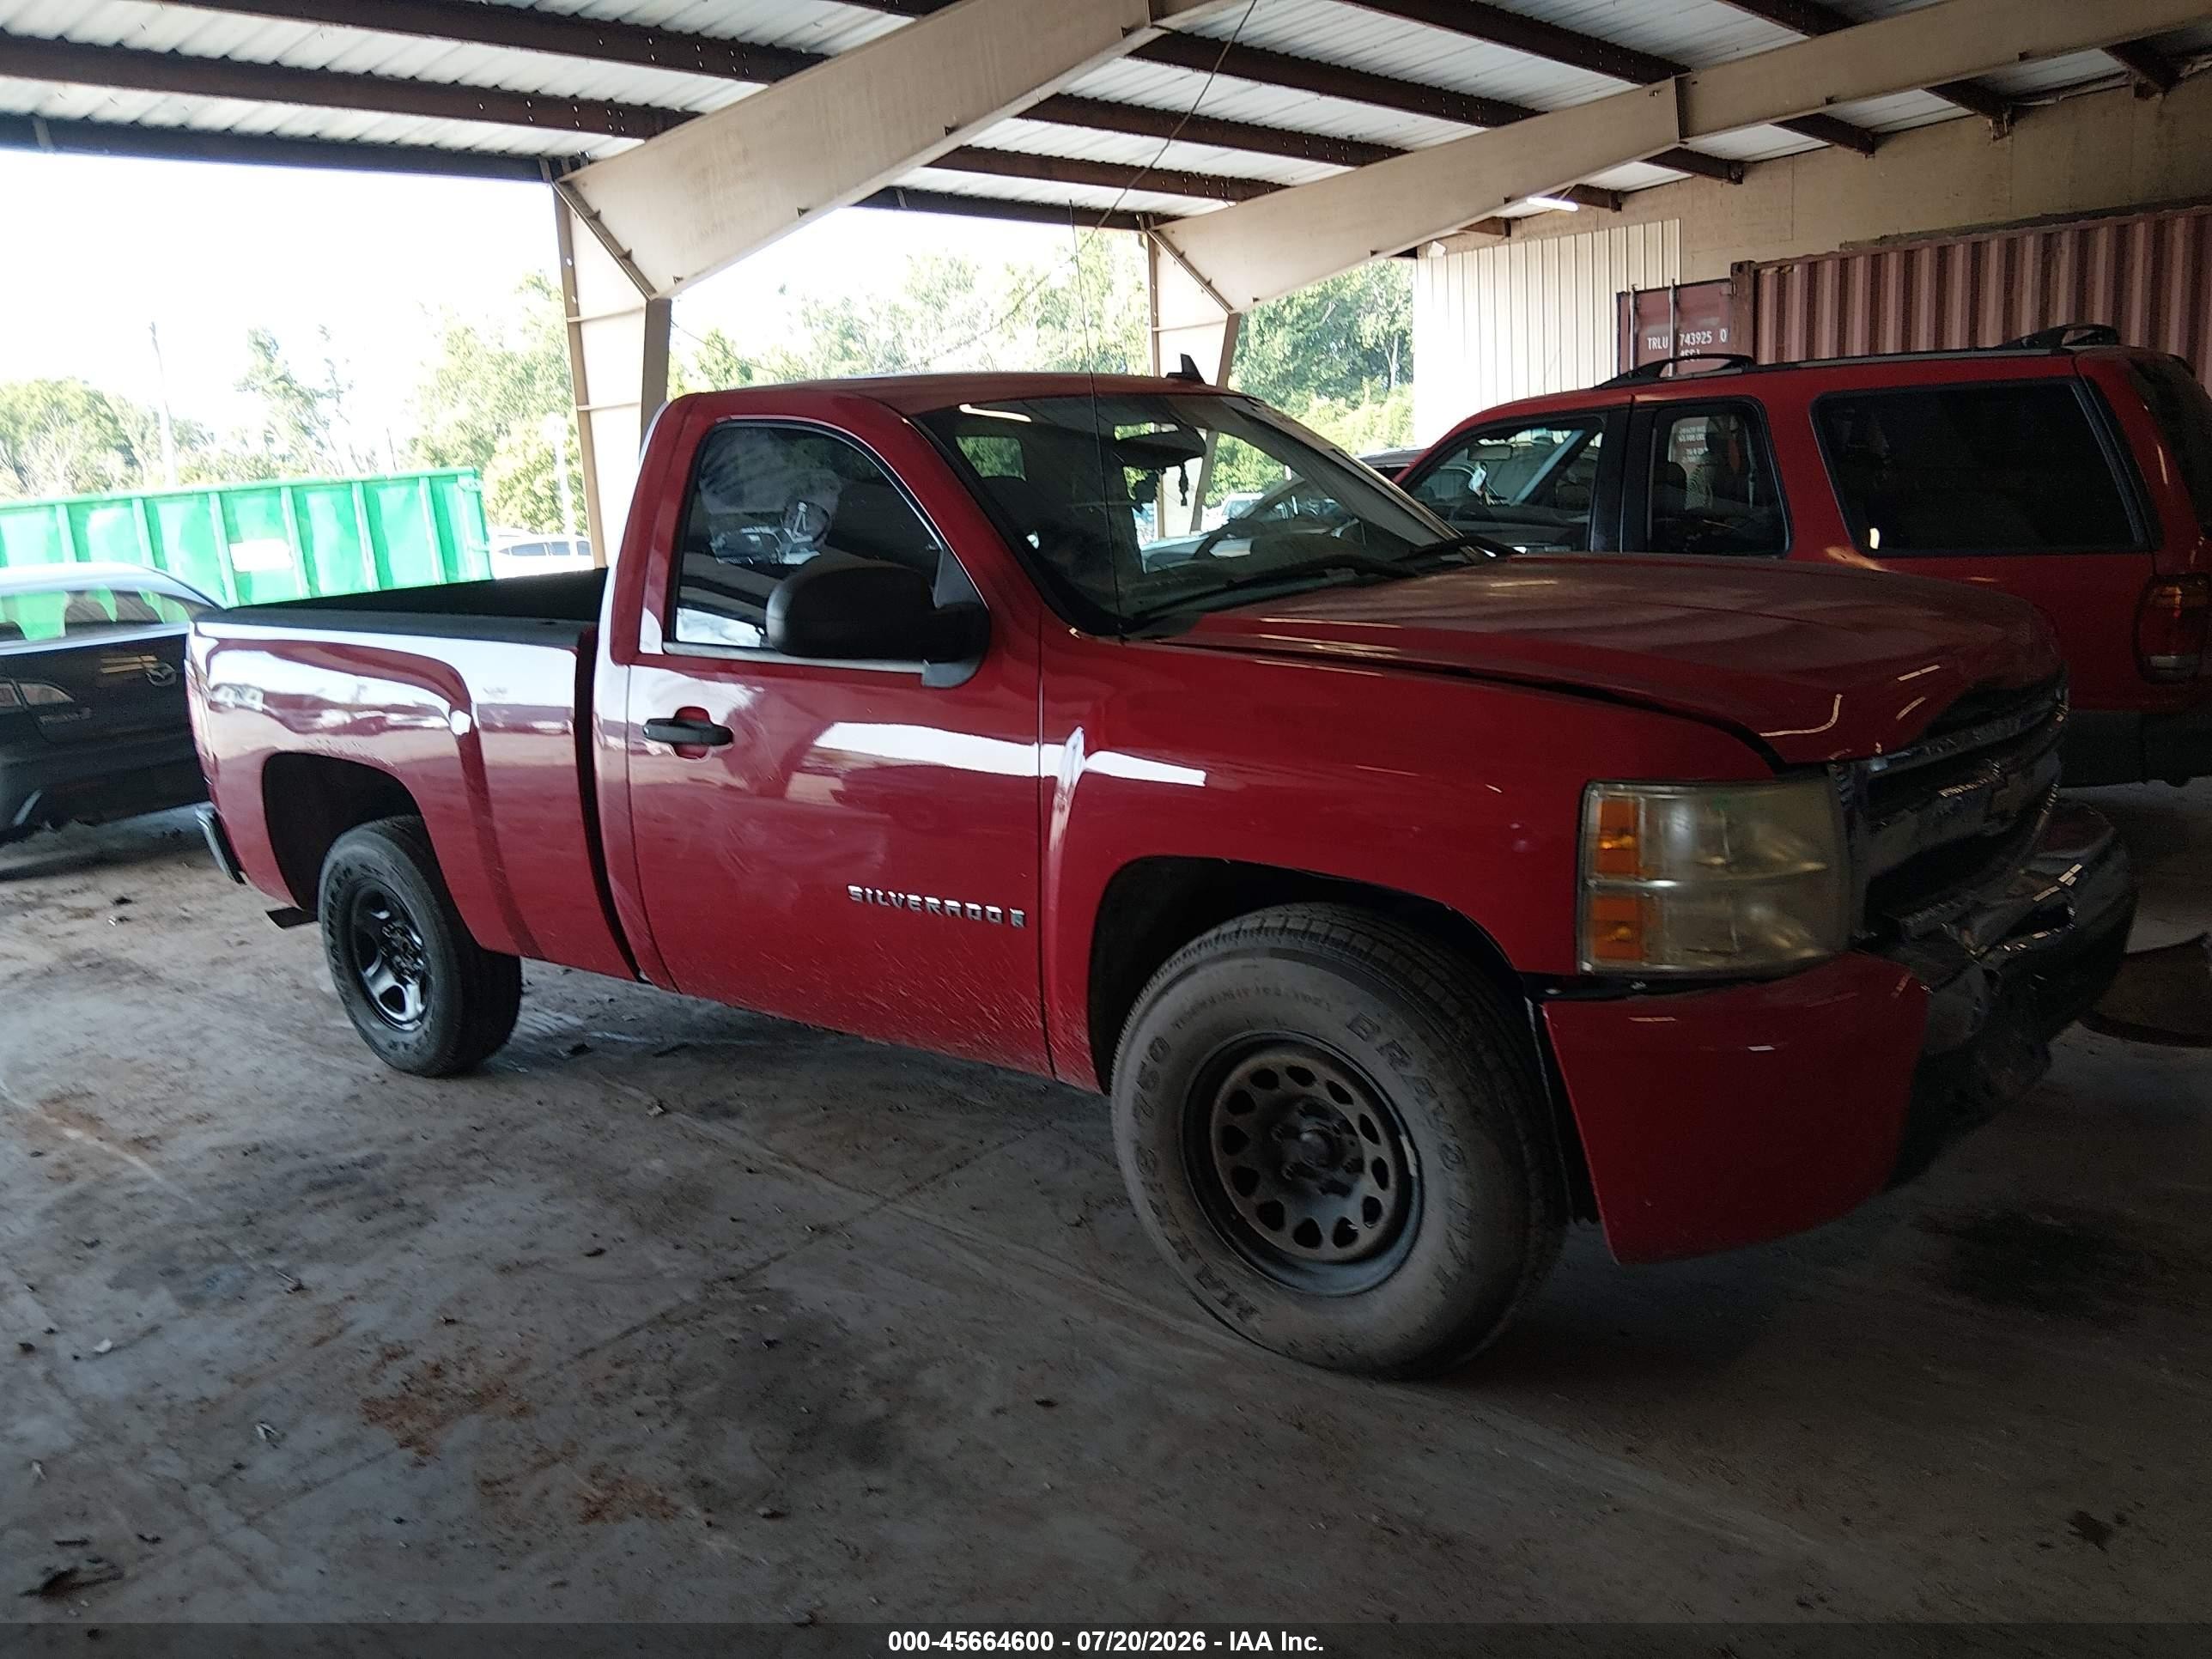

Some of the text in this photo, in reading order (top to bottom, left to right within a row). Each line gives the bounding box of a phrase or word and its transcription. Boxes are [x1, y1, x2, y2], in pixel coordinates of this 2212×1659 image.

[1647, 336, 1668, 350] TRLU
[1679, 330, 1712, 346] 743925
[848, 884, 1004, 926] SILVERADO
[1345, 1011, 1468, 1171] BRAVO
